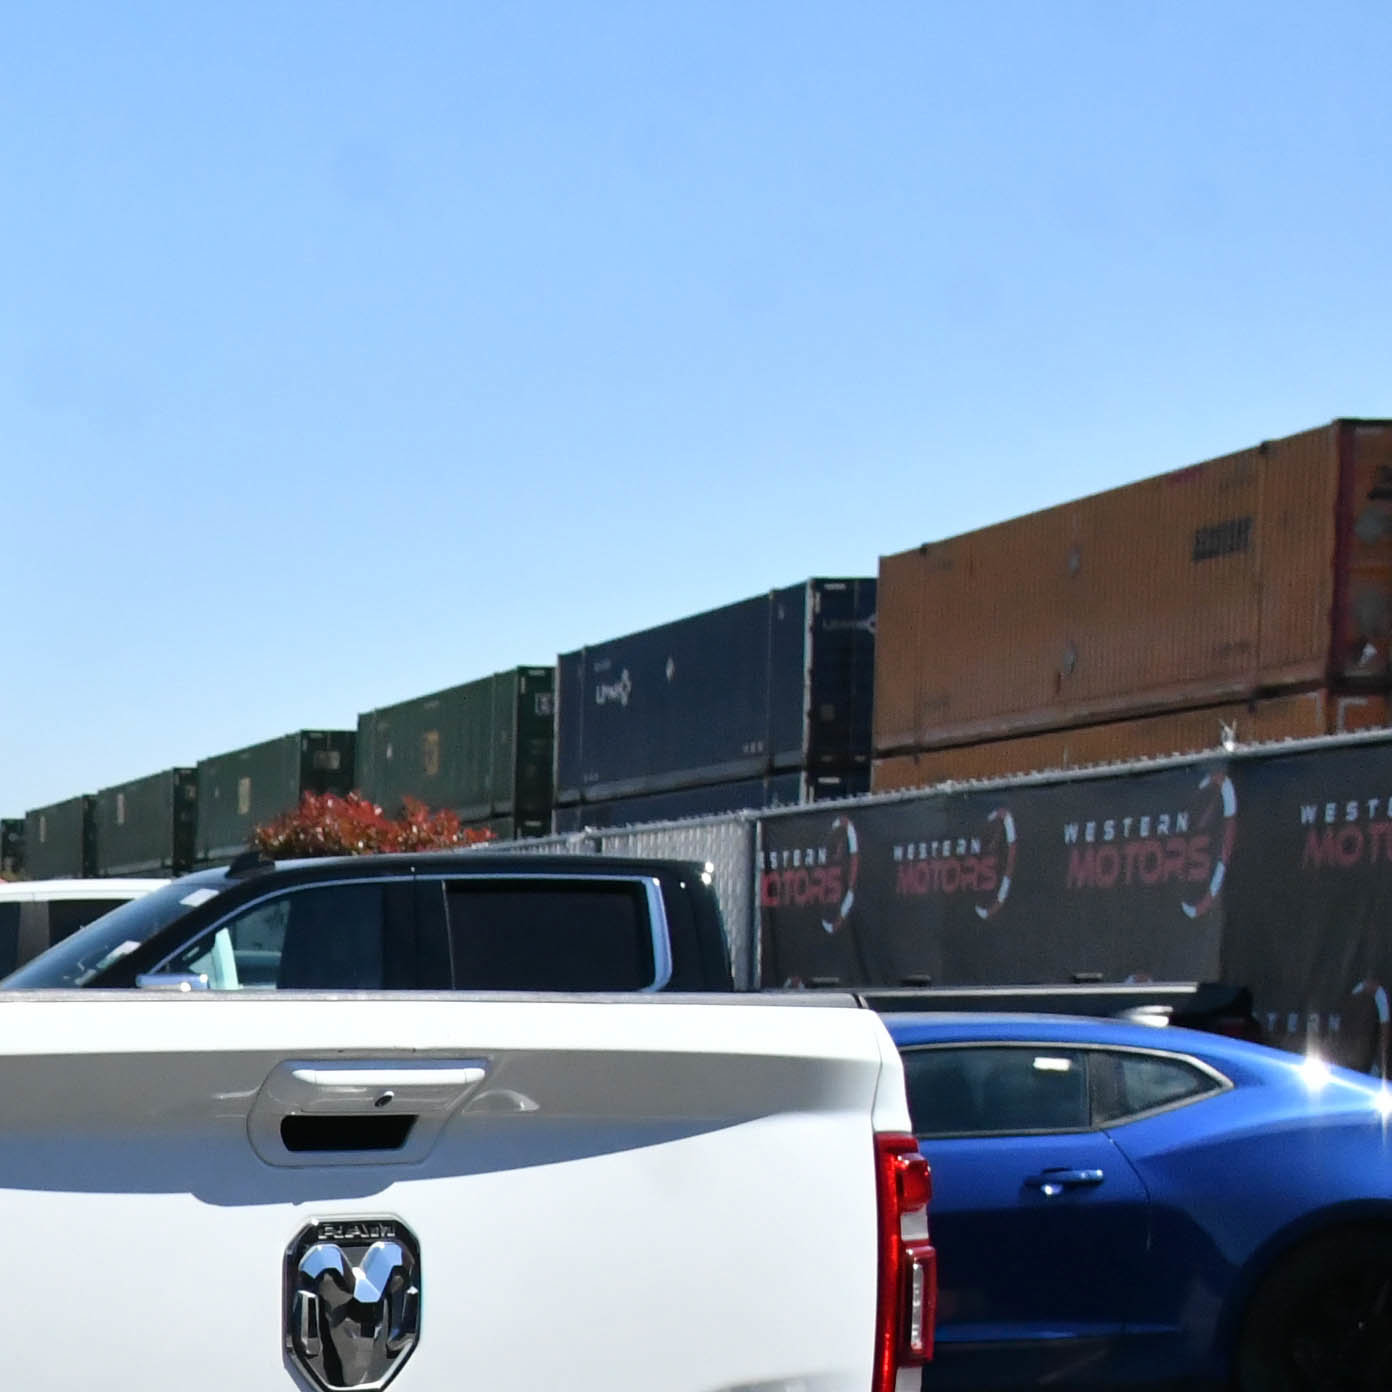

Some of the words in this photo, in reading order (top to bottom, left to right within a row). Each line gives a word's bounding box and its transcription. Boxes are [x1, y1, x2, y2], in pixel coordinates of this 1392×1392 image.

[1064, 811, 1190, 845] WESTERN
[893, 836, 982, 862] WESTERN
[1066, 834, 1211, 889] MOTORS
[896, 854, 998, 895] MOTORS
[318, 1223, 396, 1240] RAM
